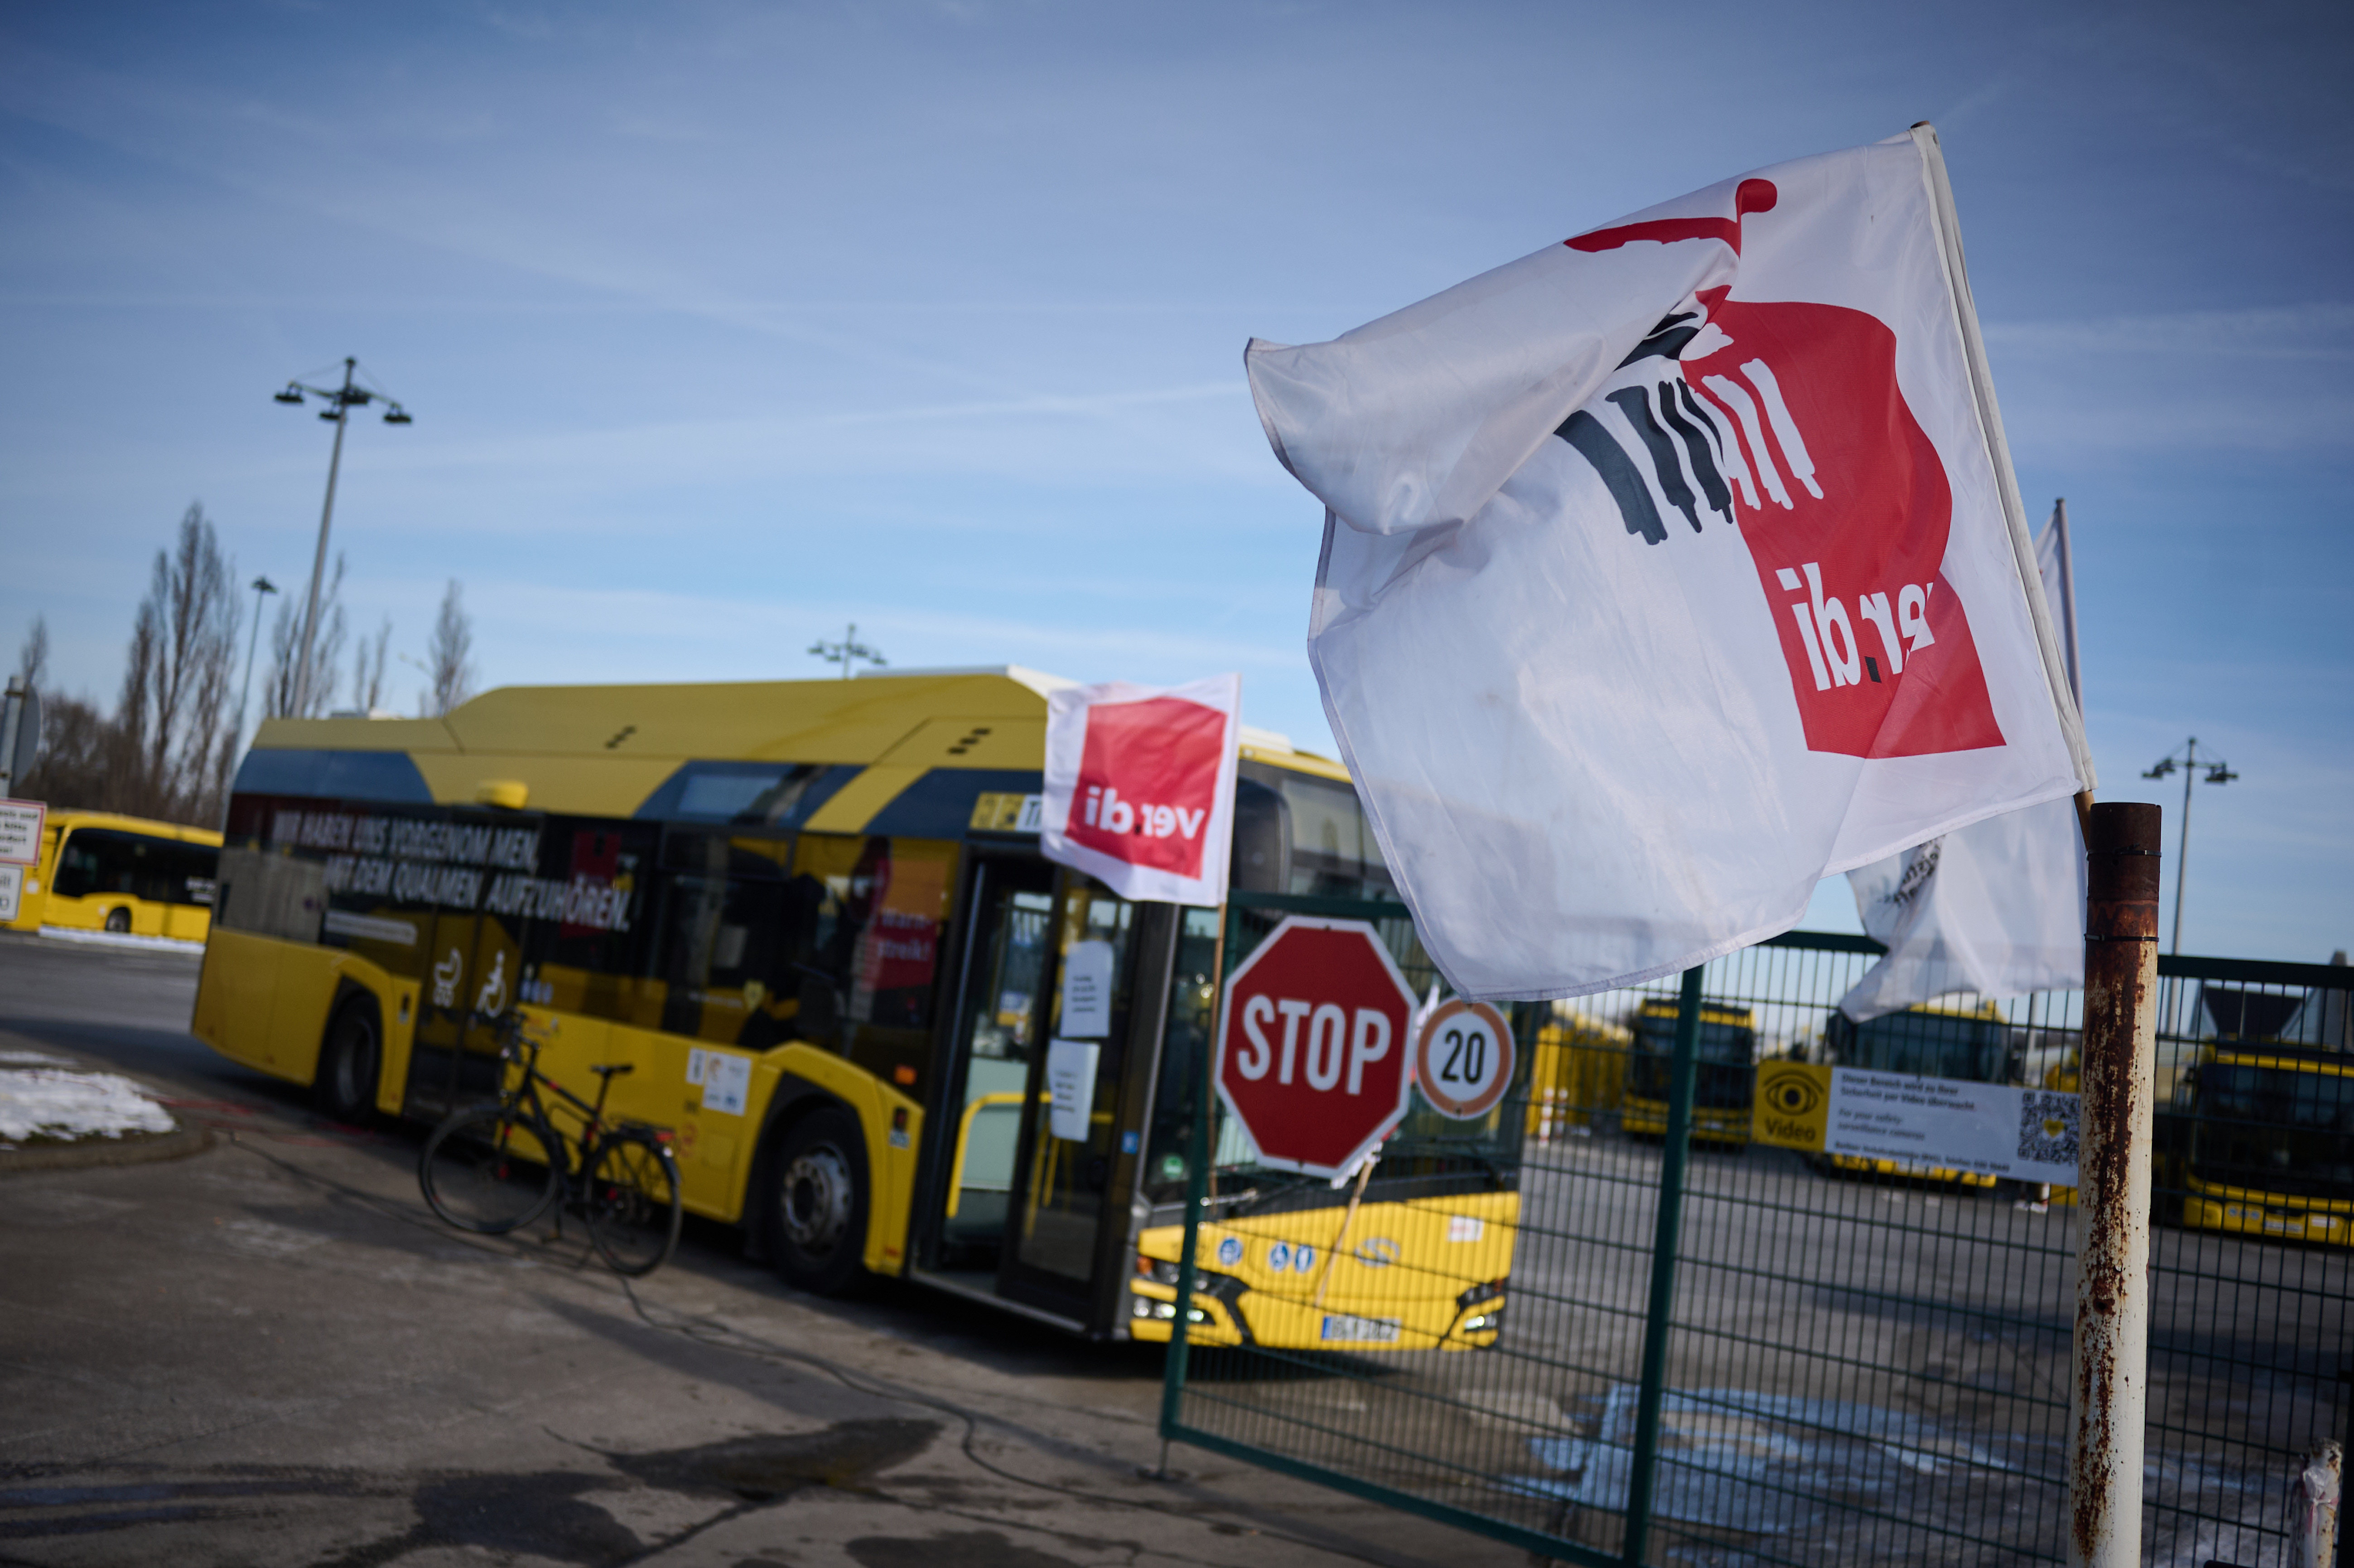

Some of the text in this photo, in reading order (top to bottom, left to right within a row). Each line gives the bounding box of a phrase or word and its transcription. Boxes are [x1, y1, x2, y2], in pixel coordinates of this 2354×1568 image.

[1237, 994, 1392, 1096] STOP
[1441, 1029, 1486, 1085] 20
[1765, 1116, 1816, 1143] Video
